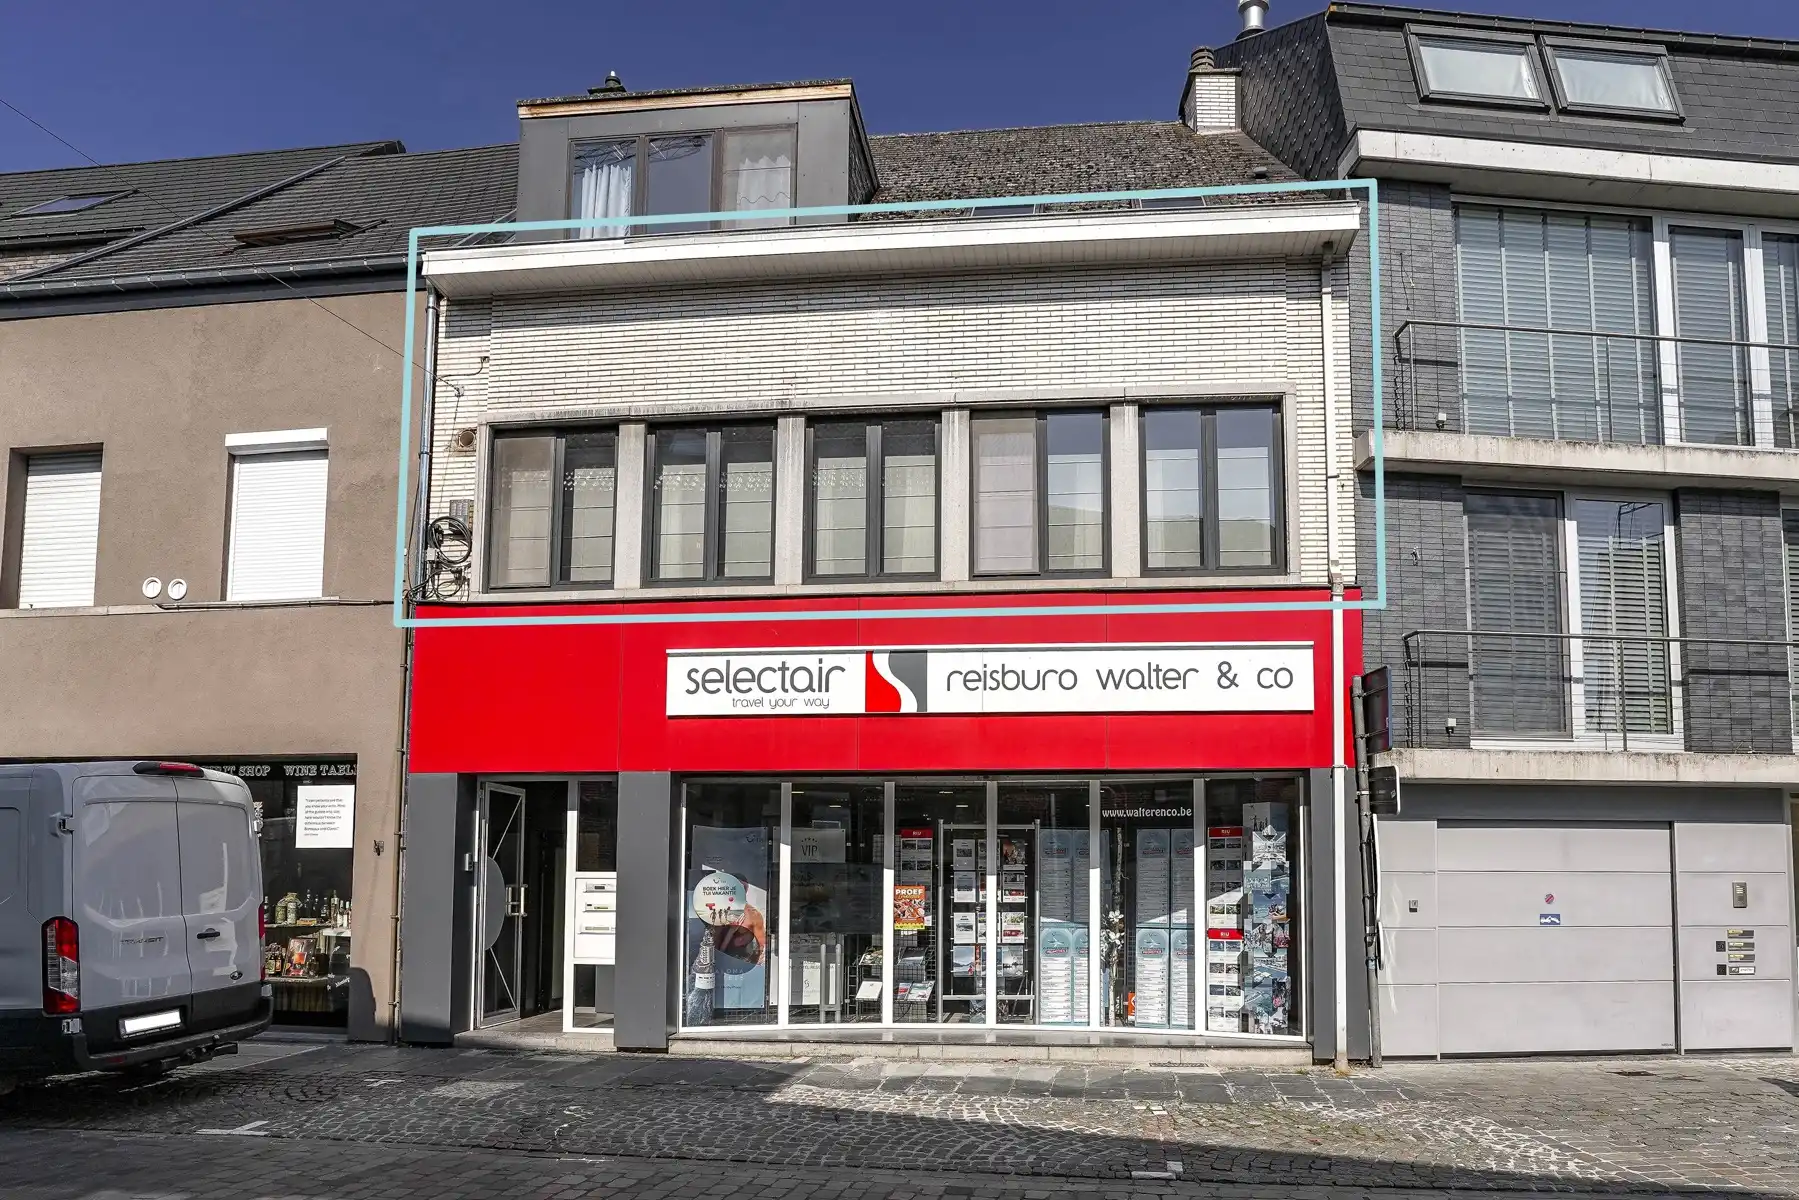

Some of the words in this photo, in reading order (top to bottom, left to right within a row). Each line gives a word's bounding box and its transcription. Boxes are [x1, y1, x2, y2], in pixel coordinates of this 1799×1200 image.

[685, 658, 846, 695] selectair
[946, 663, 1078, 692] reisburo
[1095, 661, 1200, 691] walter
[1217, 660, 1240, 690] &
[1256, 667, 1294, 689] co
[732, 696, 764, 708] travel
[769, 698, 798, 710] your
[804, 698, 830, 709] way
[238, 764, 271, 777] SHOP
[283, 765, 317, 777] WINE
[320, 764, 357, 776] TABL
[1101, 807, 1192, 818] www.walterenco.be
[801, 844, 818, 857] VIP
[895, 888, 924, 896] PROEF
